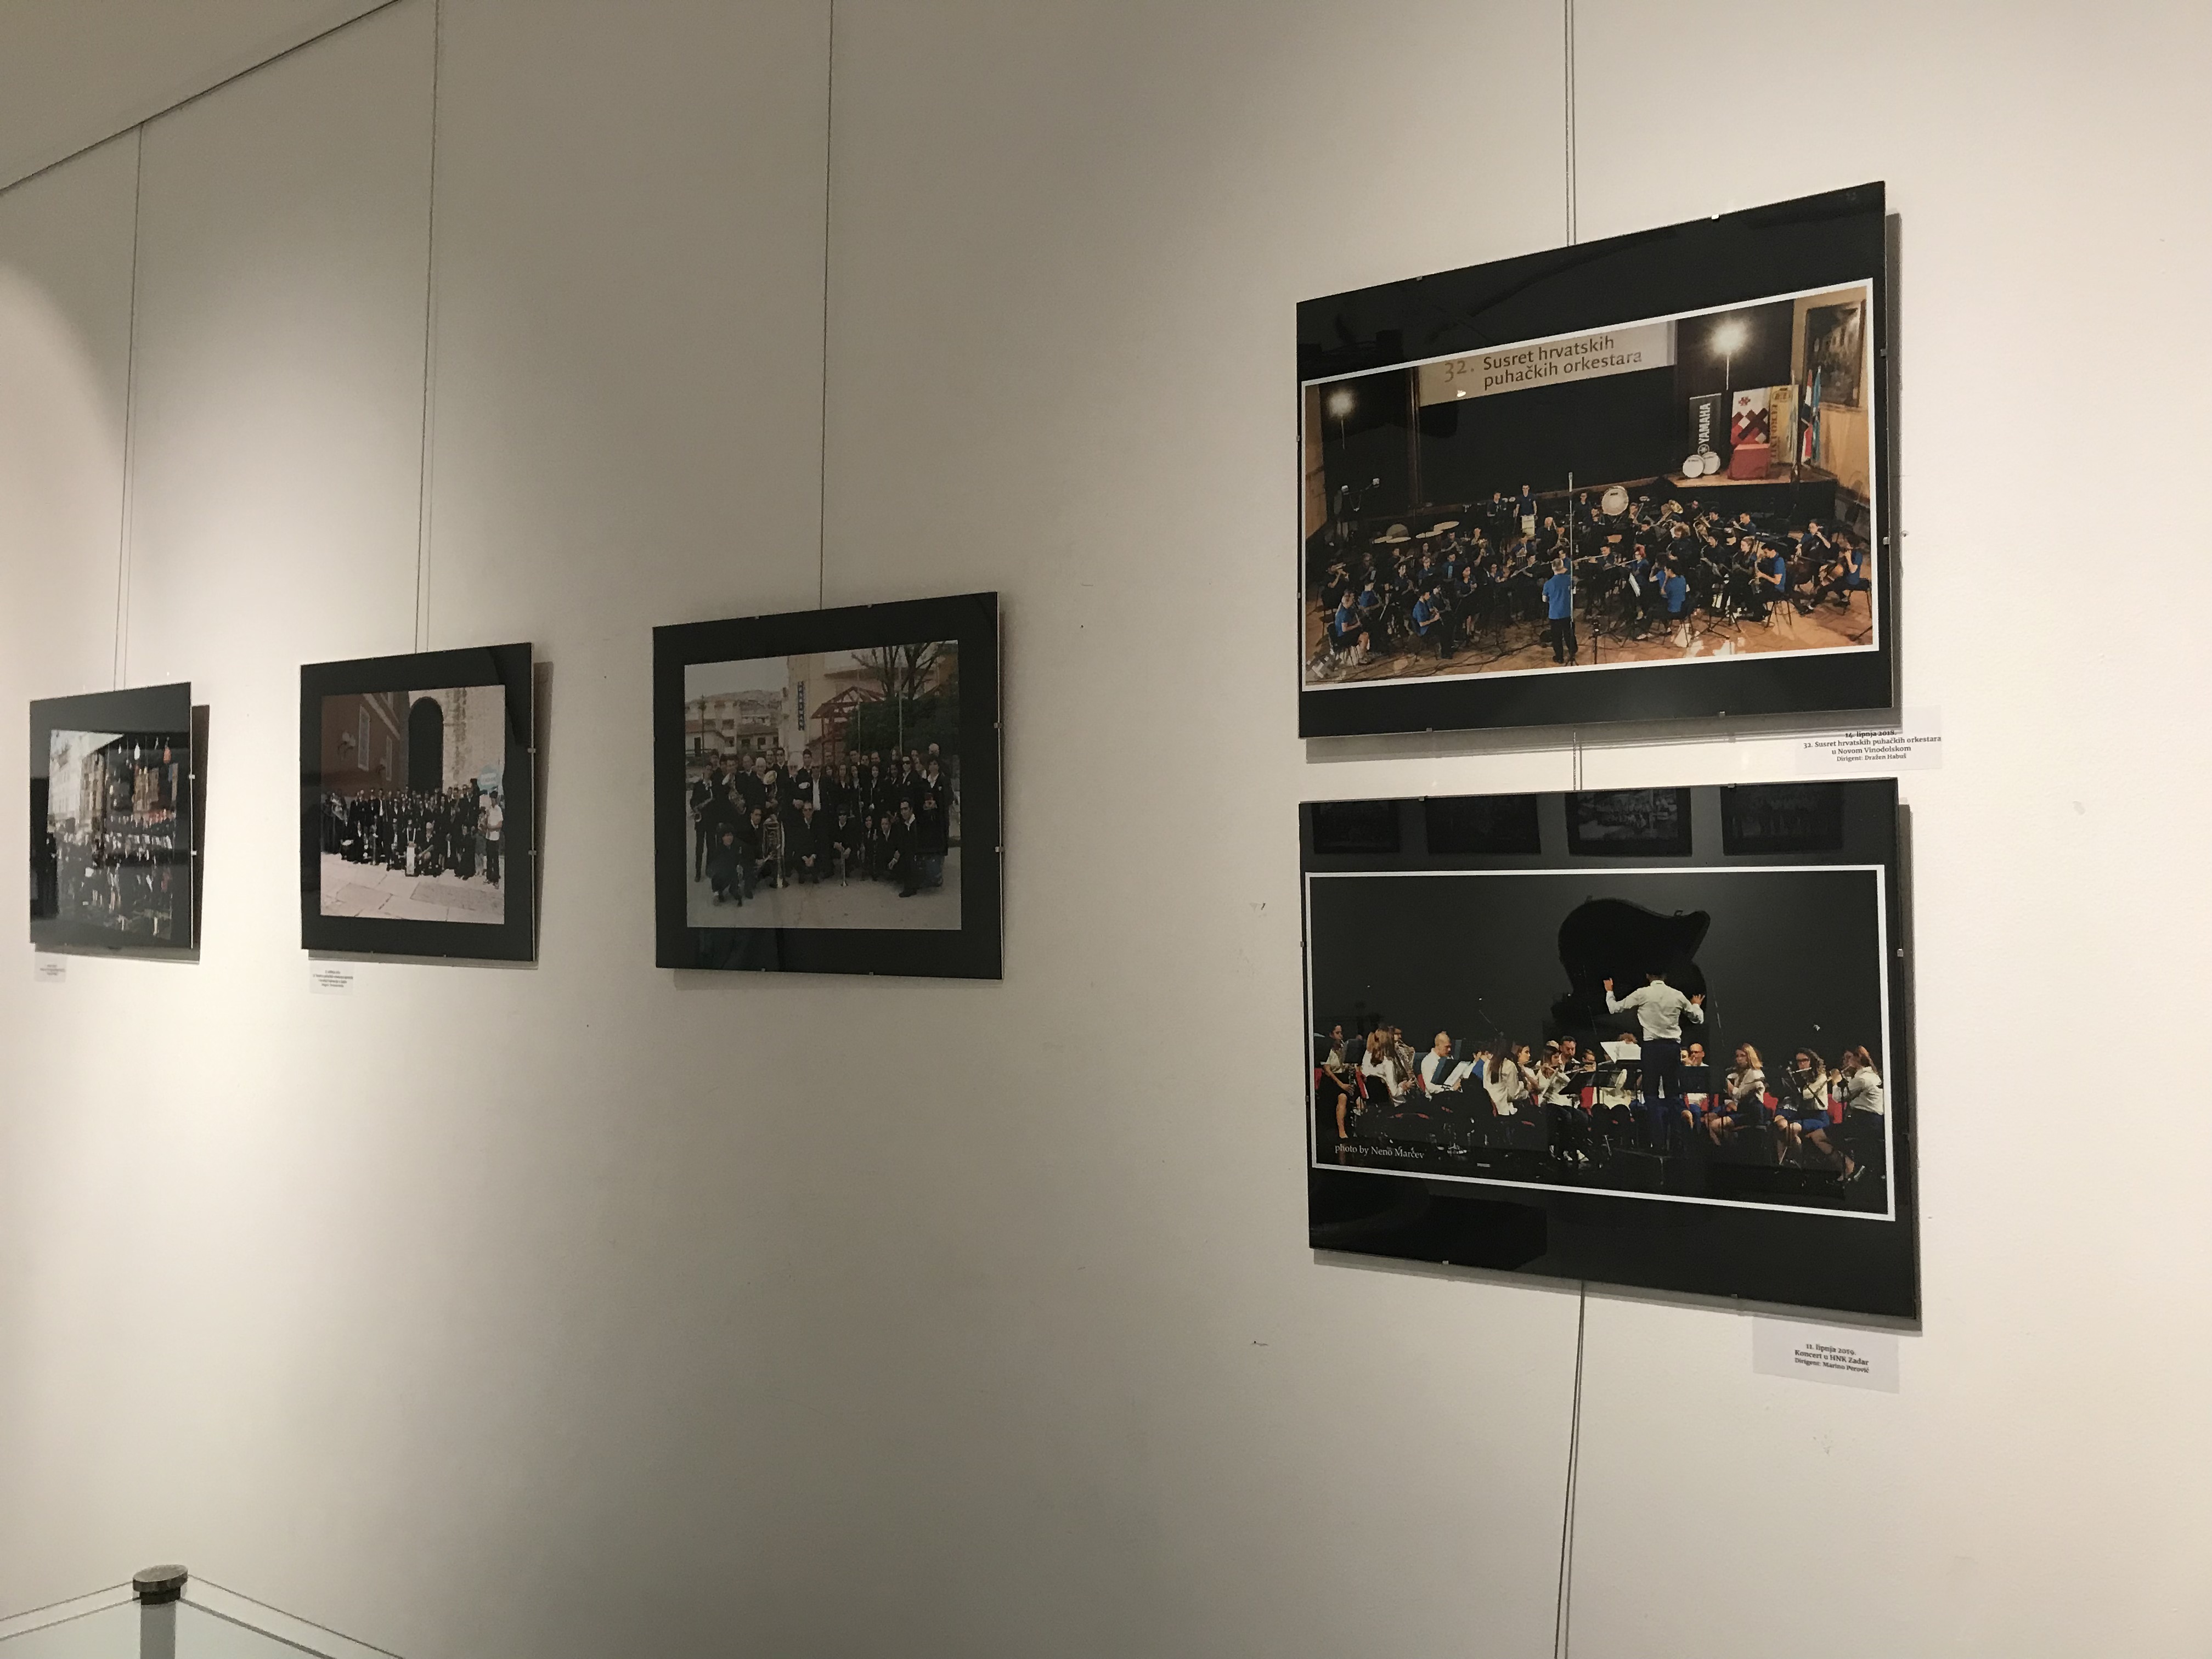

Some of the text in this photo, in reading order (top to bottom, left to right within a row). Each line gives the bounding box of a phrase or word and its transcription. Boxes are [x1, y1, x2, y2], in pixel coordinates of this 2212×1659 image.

[1444, 335, 1614, 382] 32. Susret hrvatskih
[1484, 350, 1642, 390] puhačkih orkestara
[1699, 403, 1711, 444] YAMAHA
[1838, 738, 1871, 747] hrvatskih
[1872, 737, 1905, 745] puhačkih
[1335, 1144, 1357, 1153] photo
[1359, 1145, 1369, 1156] by
[1371, 1146, 1393, 1156] Neno
[1816, 1344, 1836, 1353] lipnja
[1795, 1350, 1822, 1359] Koncert
[1830, 1355, 1847, 1363] HNK
[1848, 1357, 1869, 1365] Zadar
[1795, 1358, 1821, 1366] Dirigent:
[1822, 1362, 1846, 1370] Marino
